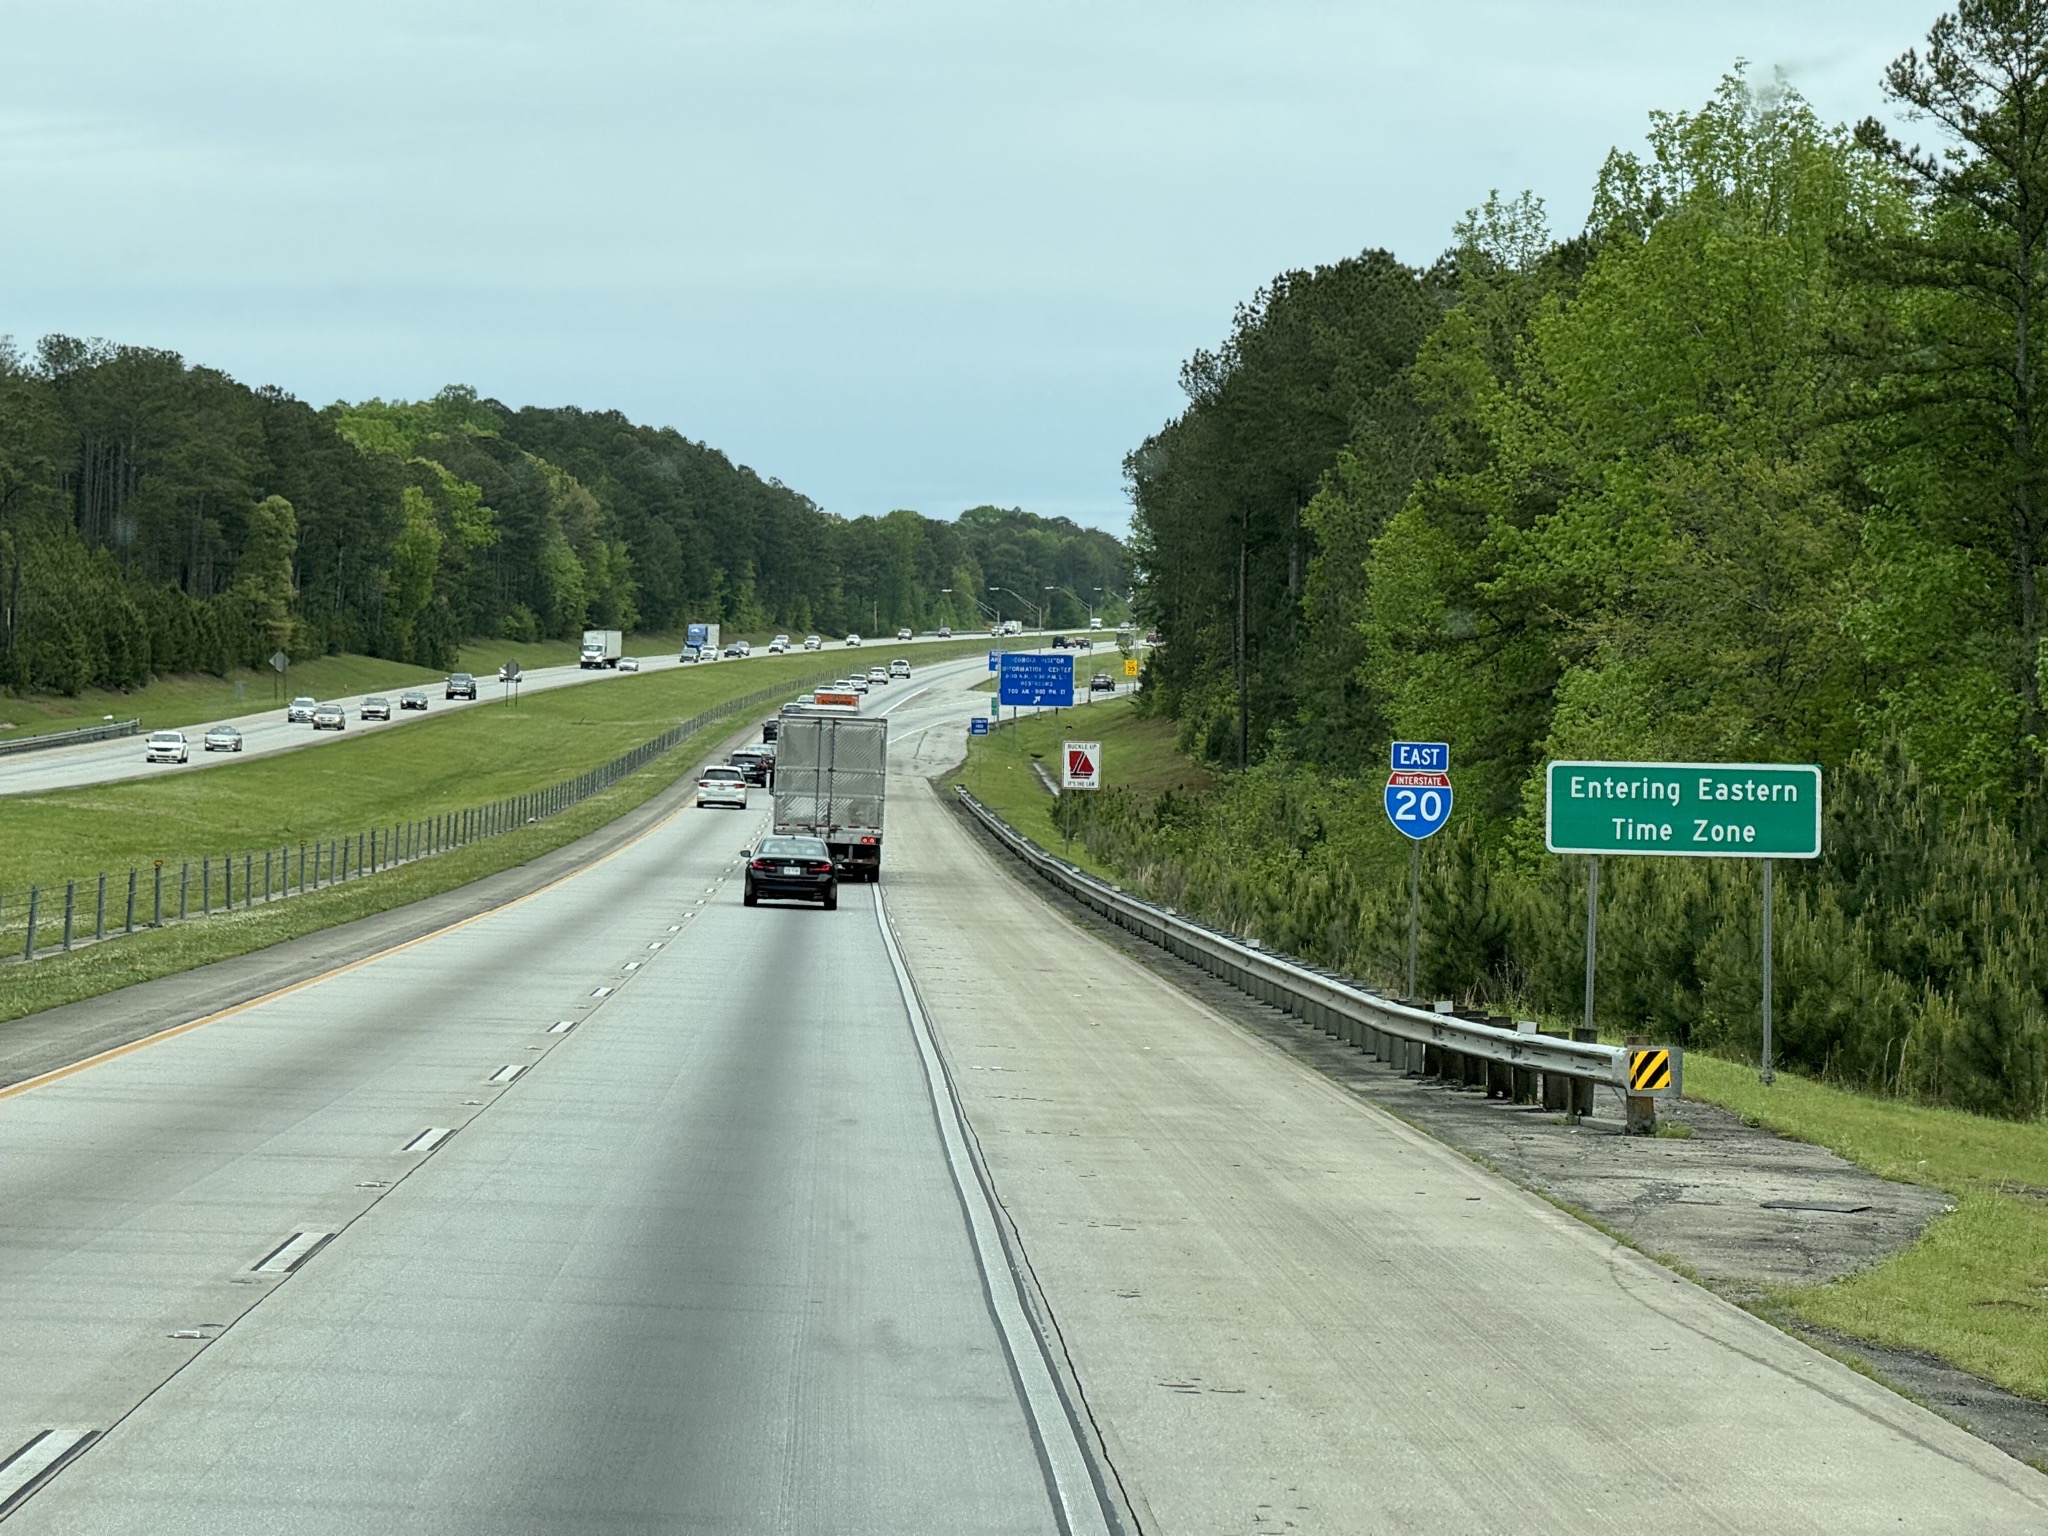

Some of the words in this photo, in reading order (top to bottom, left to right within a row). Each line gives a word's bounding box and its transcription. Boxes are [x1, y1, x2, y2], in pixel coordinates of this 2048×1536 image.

[1011, 656, 1036, 664] EORGIA
[1400, 746, 1440, 765] EAST
[1396, 776, 1442, 786] INTERSTATE
[1571, 776, 1680, 807] Entering
[1699, 778, 1798, 802] Eastern
[1395, 790, 1442, 822] 20
[1611, 818, 1673, 841] Time
[1693, 819, 1756, 843] Zone
